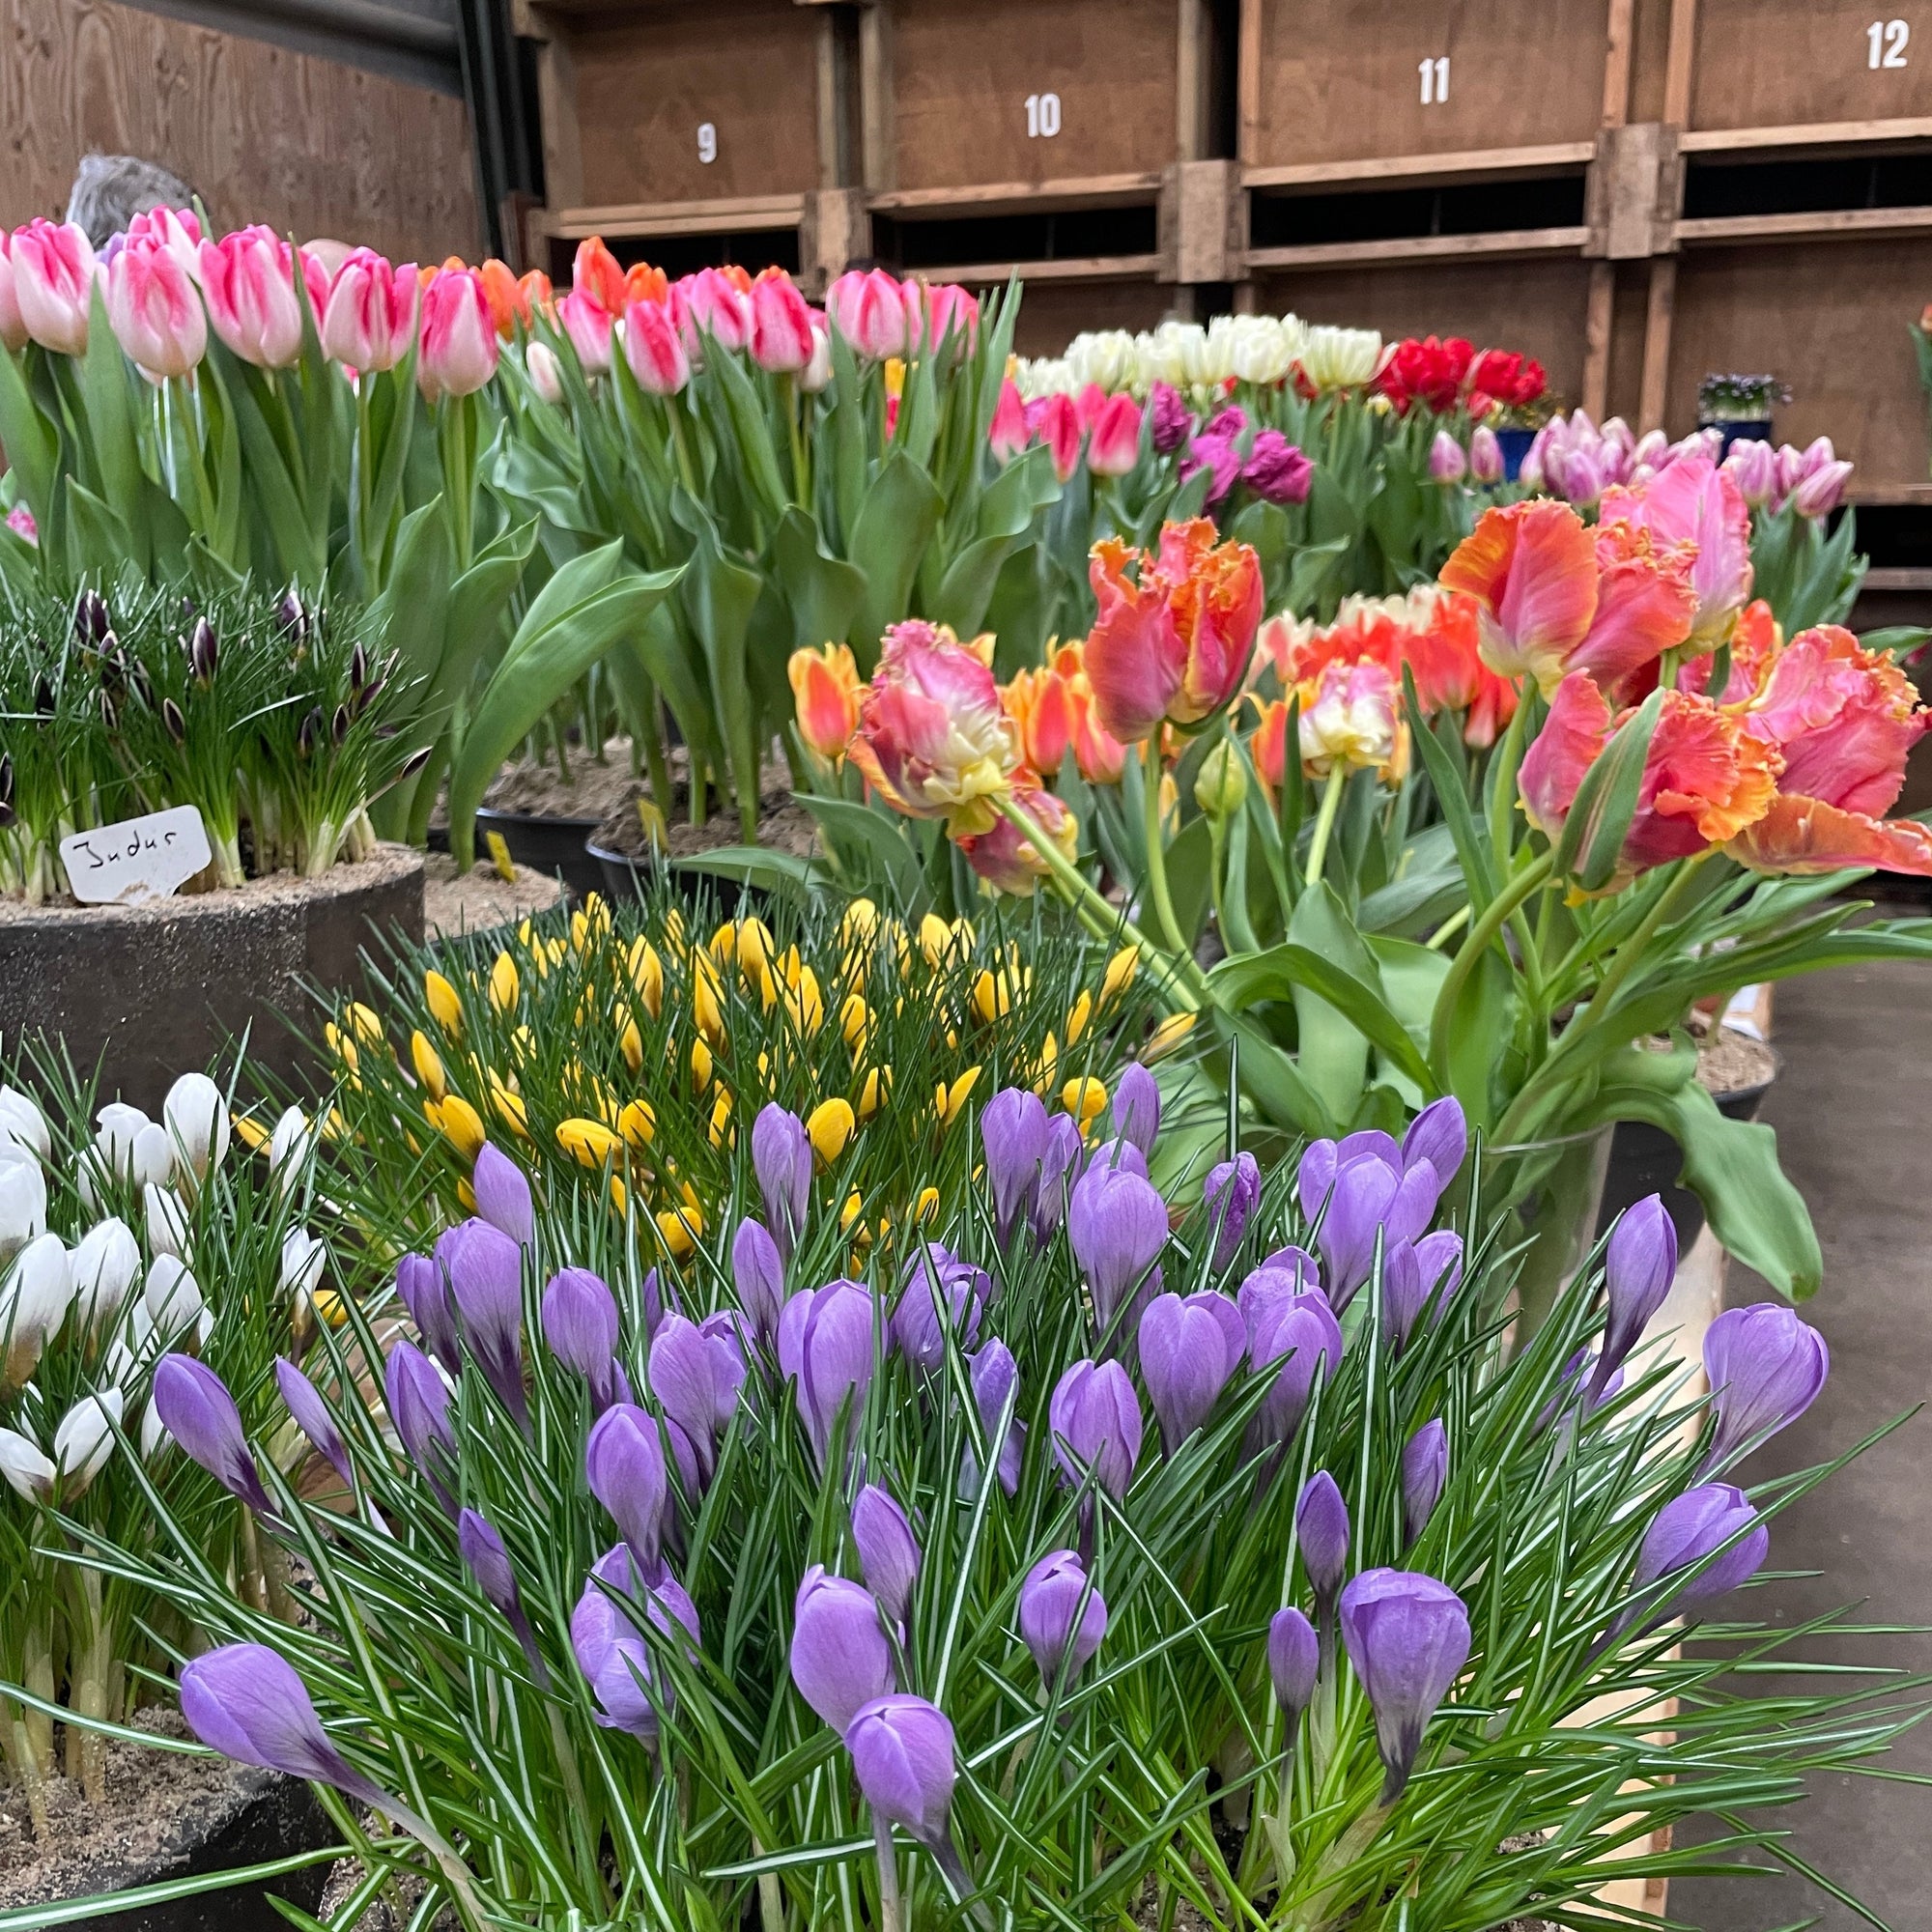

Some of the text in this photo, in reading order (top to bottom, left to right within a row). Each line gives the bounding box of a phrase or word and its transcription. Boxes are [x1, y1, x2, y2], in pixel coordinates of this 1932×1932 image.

[1866, 18, 1910, 70] 12
[1418, 56, 1450, 105] 11
[1024, 93, 1062, 138] 10
[697, 123, 717, 164] 9
